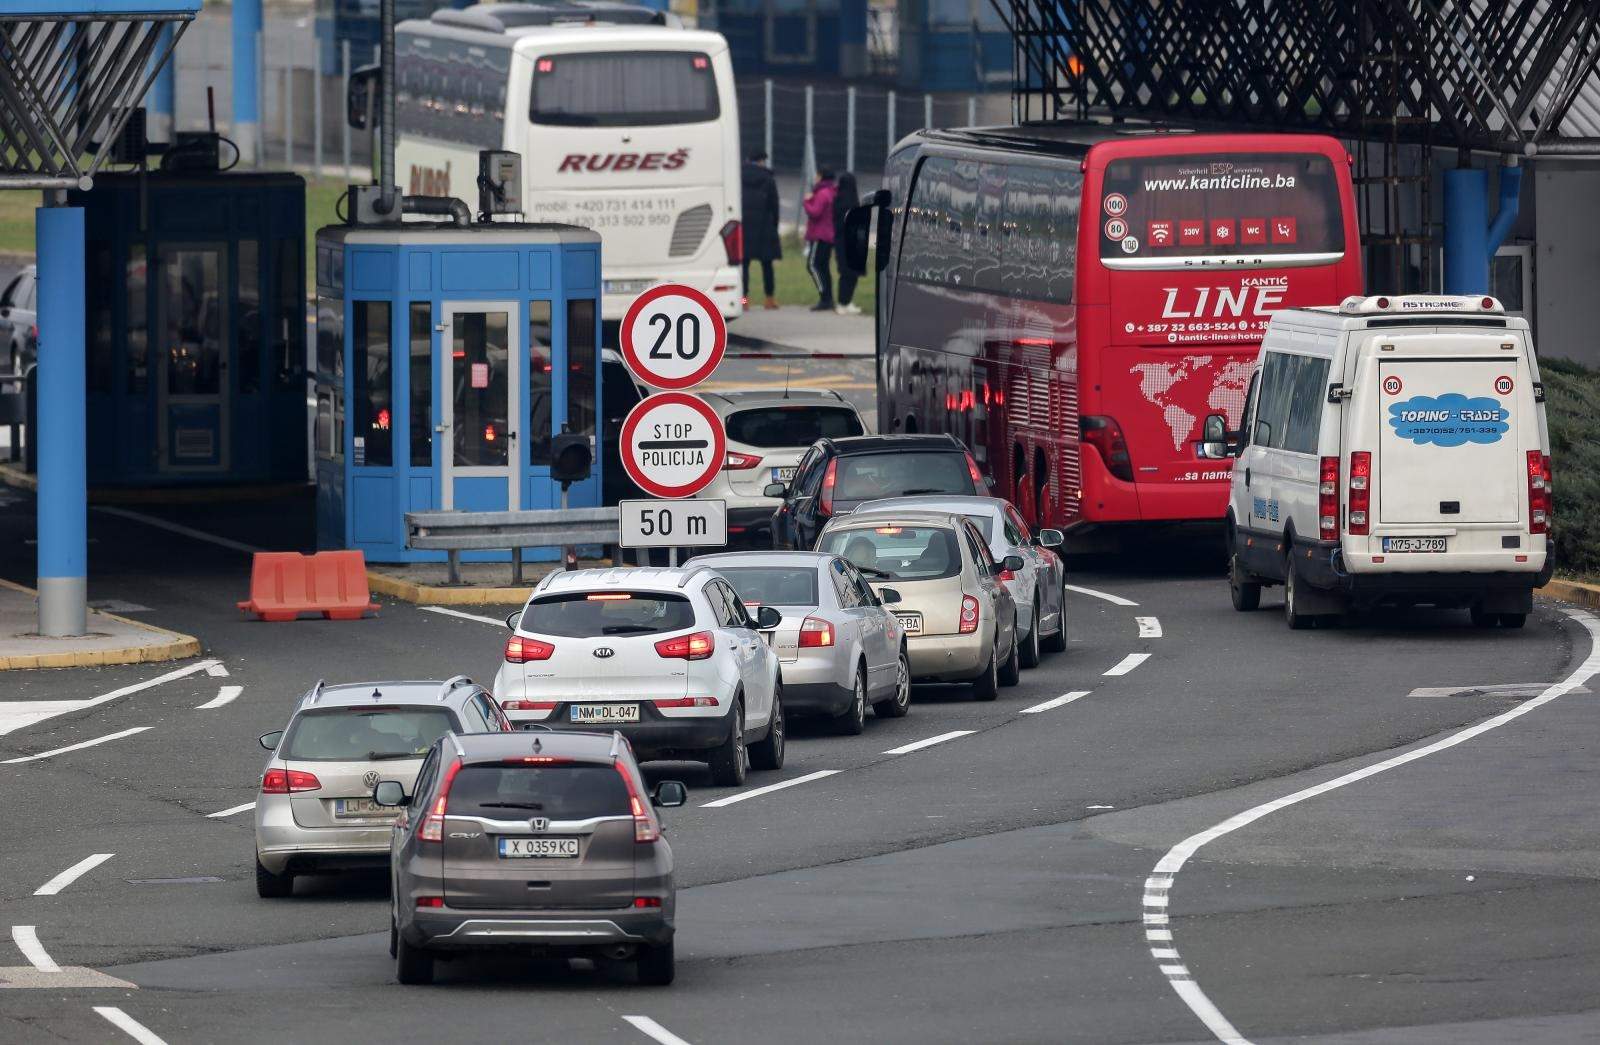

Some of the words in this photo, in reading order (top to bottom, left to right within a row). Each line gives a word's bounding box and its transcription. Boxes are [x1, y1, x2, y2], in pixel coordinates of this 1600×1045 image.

[558, 148, 692, 173] RUBEŠ
[1144, 174, 1296, 192] www.kanticline.ba
[606, 200, 627, 212] 731
[631, 200, 651, 211] 414
[1109, 200, 1123, 209] 100
[1111, 225, 1122, 233] 80
[1247, 227, 1260, 235] WC
[1241, 275, 1289, 287] KANTIĆ
[1161, 286, 1288, 319] LINE
[1147, 324, 1168, 332] 387
[1171, 323, 1185, 332] 32
[1188, 322, 1237, 332] 663-524
[648, 313, 701, 361] 20
[1387, 381, 1398, 390] 80
[1499, 381, 1510, 390] 100
[1400, 410, 1450, 422] TOPING
[1460, 410, 1500, 421] TRADE
[654, 424, 693, 439] STOP
[642, 450, 704, 467] POLICIJA
[640, 509, 673, 536] 50
[687, 515, 707, 535] m
[1391, 539, 1444, 550] M75-J-789
[595, 648, 613, 656] KIA
[579, 706, 595, 719] NM
[602, 706, 637, 718] DL-047
[346, 800, 360, 812] LJ
[512, 841, 519, 853] X
